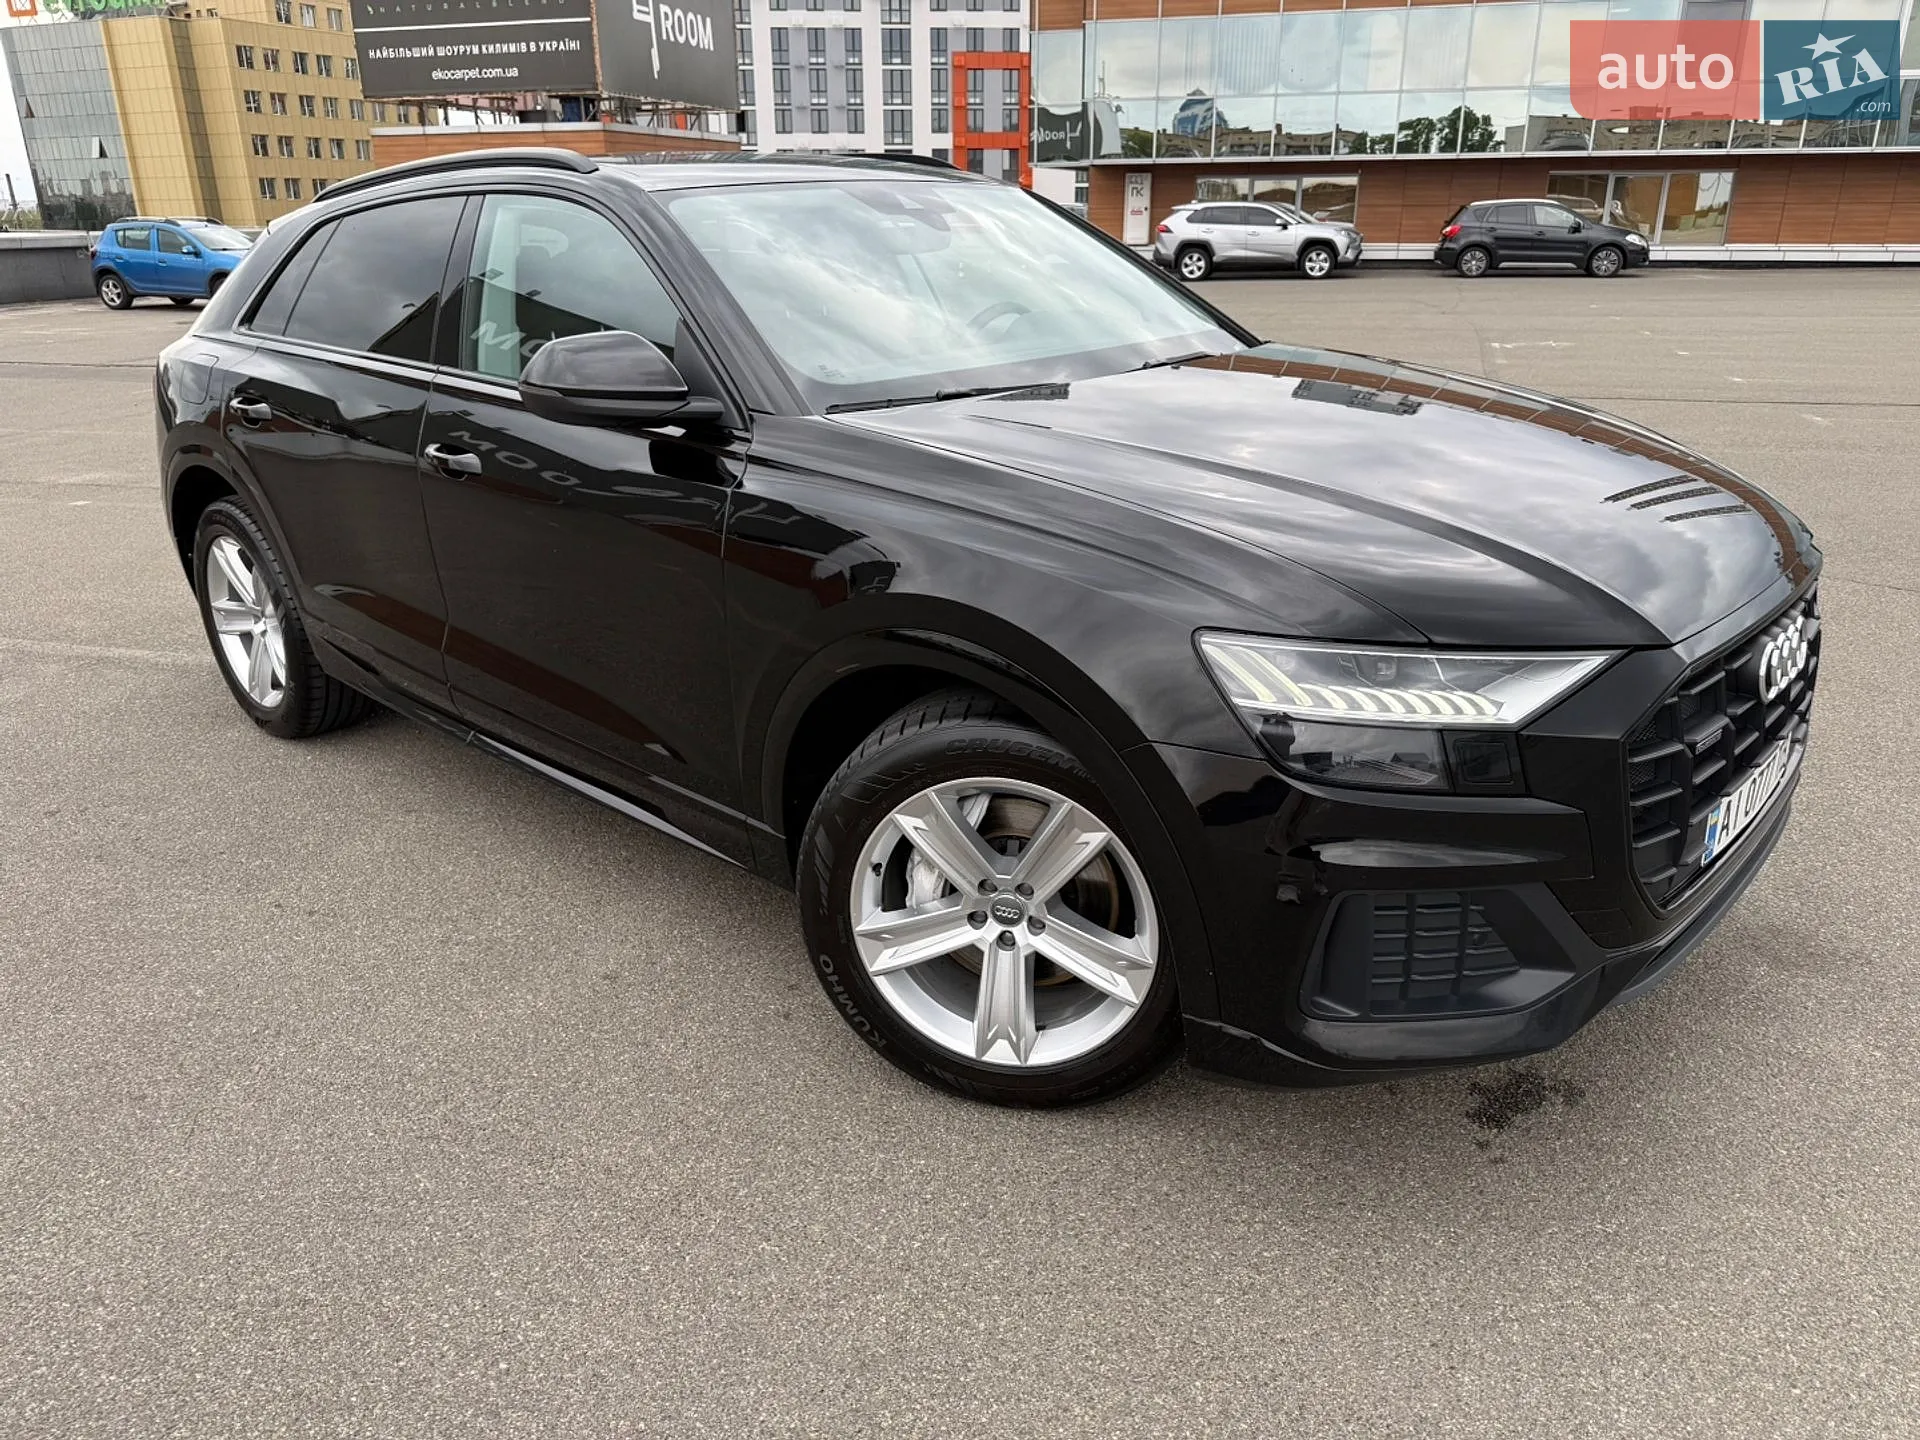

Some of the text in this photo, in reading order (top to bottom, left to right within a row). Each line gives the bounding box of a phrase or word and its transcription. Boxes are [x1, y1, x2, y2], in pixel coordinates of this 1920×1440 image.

[659, 3, 714, 51] ROOM
[368, 38, 580, 59] НАЙБІЛЬШИЙ ШОУРУМ КИЛИМІВ В УКРАЇНІ
[431, 66, 519, 81] ekocarpet.com.ua
[818, 953, 888, 1048] KUMHO
